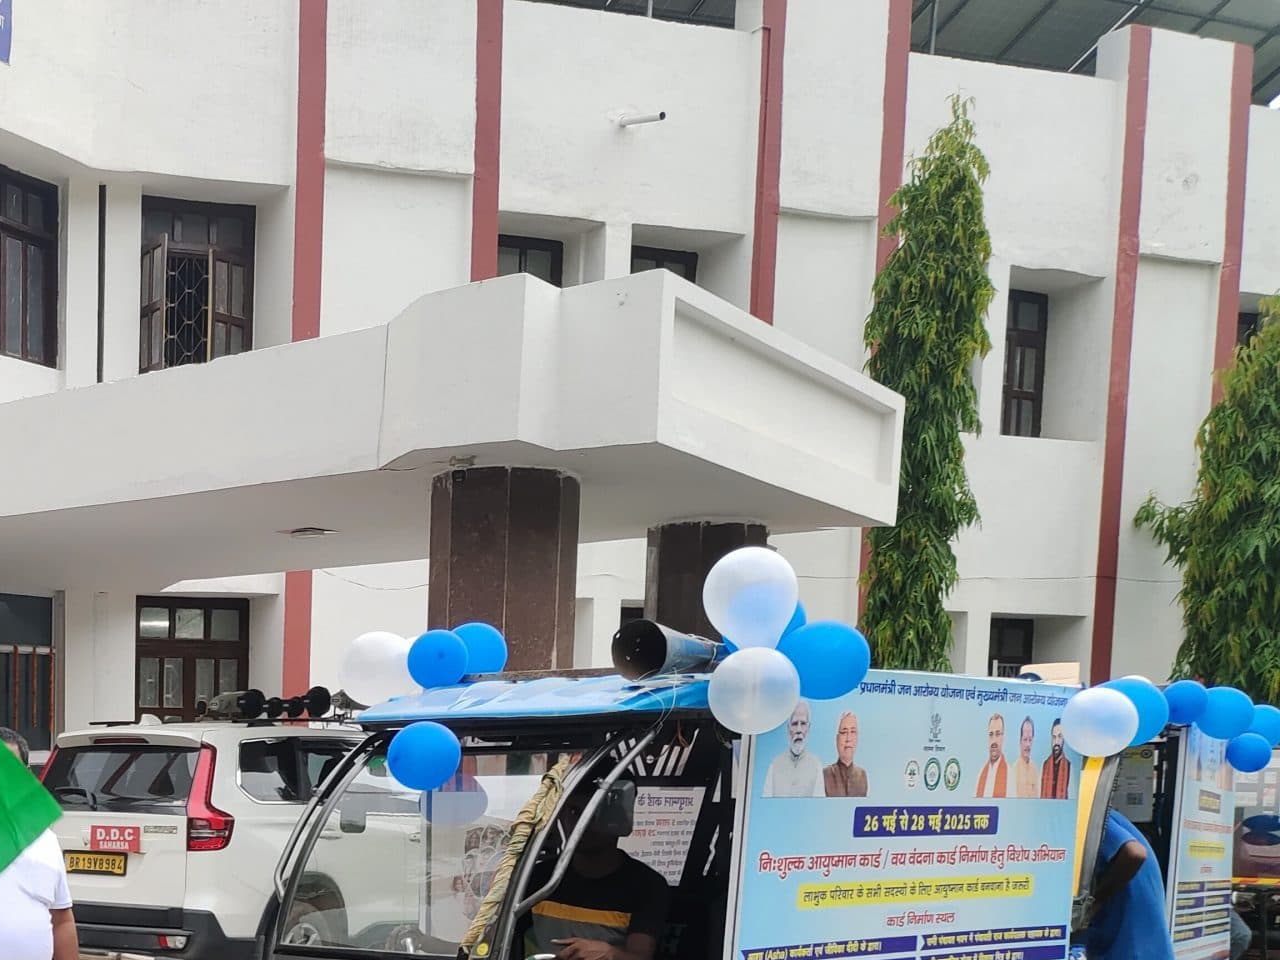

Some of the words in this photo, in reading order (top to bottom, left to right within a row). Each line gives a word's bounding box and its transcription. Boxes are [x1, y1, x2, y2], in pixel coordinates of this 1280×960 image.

[860, 680, 896, 695] प्रधानमंत्री
[897, 684, 912, 696] जन
[913, 682, 939, 697] आरोग्य
[941, 684, 964, 699] योजना
[966, 686, 975, 700] एवं
[977, 688, 1008, 706] मुख्यमंत्री
[863, 815, 878, 832] 26
[881, 809, 898, 833] मई
[899, 810, 909, 831] से
[911, 814, 925, 831] 28
[928, 809, 943, 832] मई
[944, 814, 970, 831] 2025
[973, 813, 990, 831] तक
[96, 828, 134, 840] D.D.C
[99, 841, 129, 850] SAHARSA
[807, 853, 856, 877] आयुष्मान
[859, 848, 882, 868] कार्ड
[891, 852, 906, 866] वय
[908, 848, 934, 865] वंदना
[936, 845, 958, 865] कार्ड
[958, 845, 988, 864] निर्माण
[990, 846, 1005, 870] हेतु
[1007, 844, 1029, 863] विशेष
[1032, 844, 1066, 862] अभियान
[803, 890, 827, 906] लाभुक
[829, 885, 853, 901] परिवार
[856, 884, 864, 898] के
[866, 884, 881, 899] सभी
[910, 882, 916, 895] के
[919, 881, 932, 896] लिए
[934, 883, 964, 898] आयुष्मान
[966, 878, 980, 892] कार्ड
[886, 912, 905, 927] कार्ड
[907, 909, 934, 925] निर्माण
[935, 912, 955, 923] स्थल
